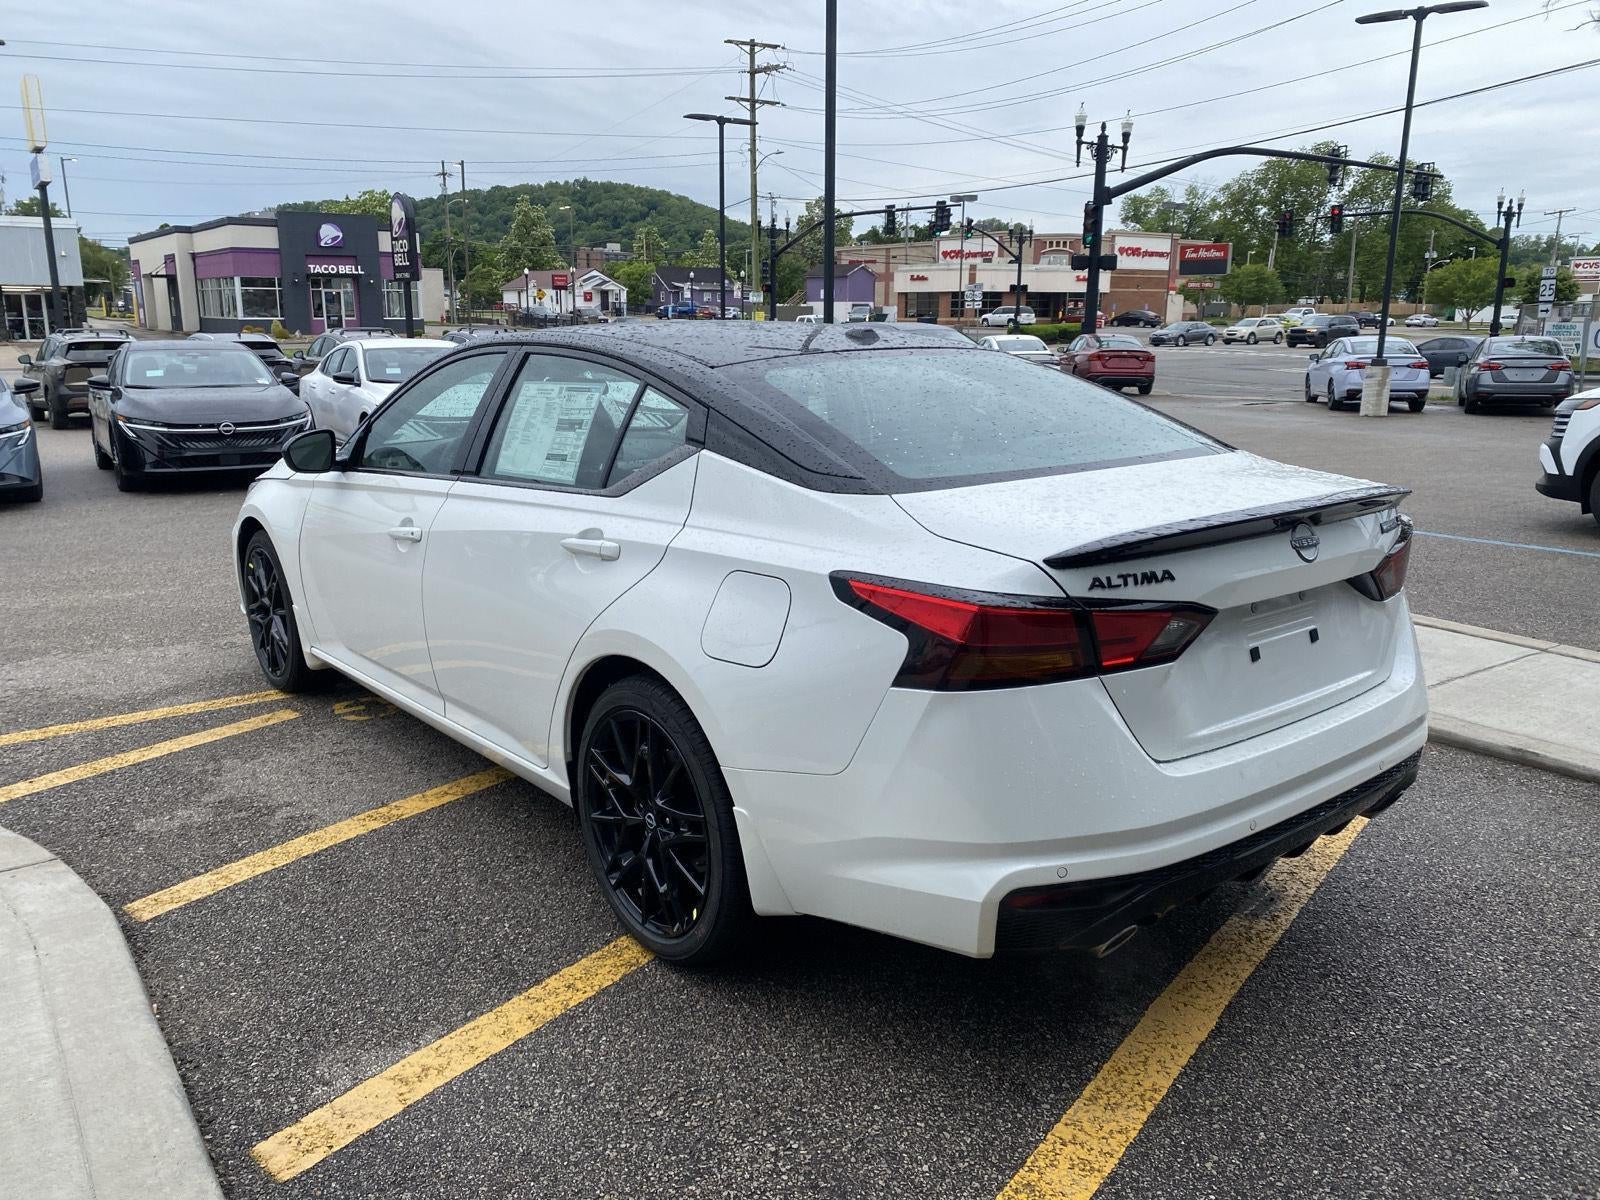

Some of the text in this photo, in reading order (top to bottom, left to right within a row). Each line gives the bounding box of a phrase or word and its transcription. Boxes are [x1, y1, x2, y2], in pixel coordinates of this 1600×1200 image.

[392, 239, 408, 253] TACO
[394, 253, 410, 266] BELL
[1126, 246, 1171, 260] CVS pharmacy
[1184, 248, 1197, 259] Tim
[308, 264, 365, 275] TACO BELL
[1540, 284, 1555, 297] 25
[1088, 569, 1176, 592] ALTIMA
